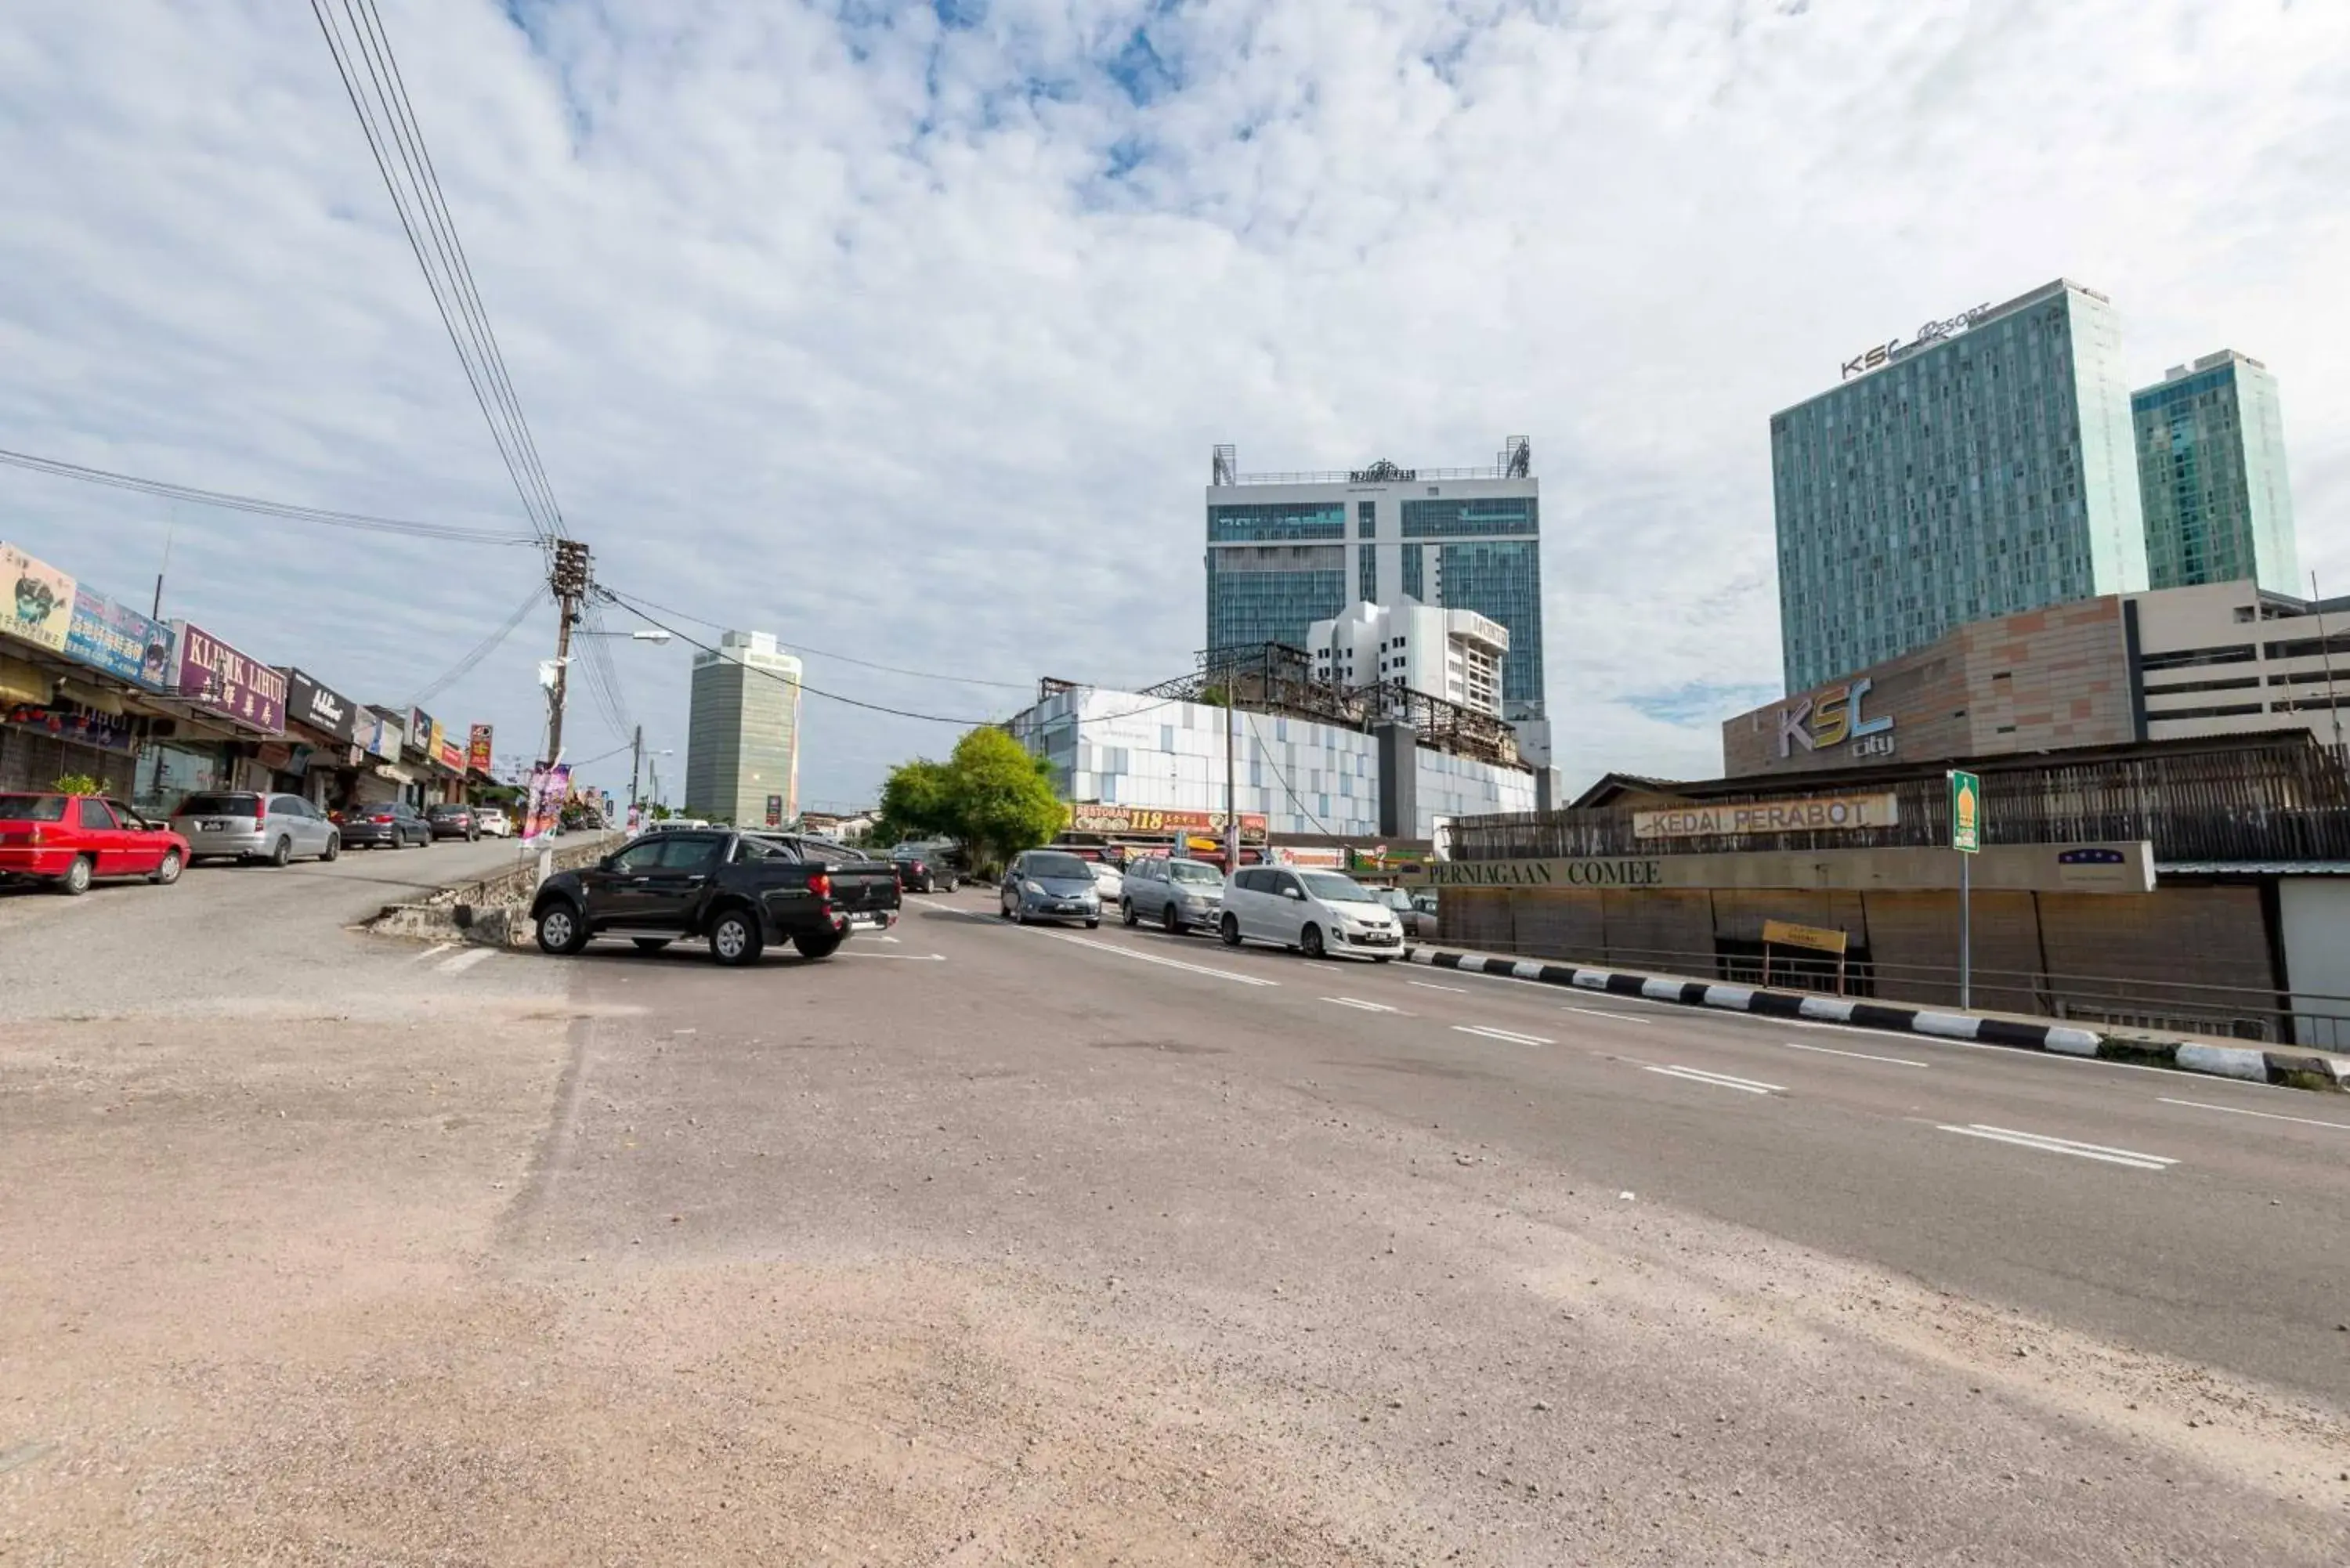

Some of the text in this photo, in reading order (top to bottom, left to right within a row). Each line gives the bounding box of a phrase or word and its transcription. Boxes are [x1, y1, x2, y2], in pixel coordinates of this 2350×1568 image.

[189, 632, 244, 685] KLINIK
[248, 664, 283, 705] LIHUI
[1777, 676, 1895, 759] KSL
[1852, 735, 1896, 757] city
[1076, 804, 1129, 818] RESTORAN
[1131, 811, 1162, 829] 118
[1651, 800, 1868, 835] KEDAI PERABOT
[1429, 860, 1662, 884] PERNIAGAAN COMEE
